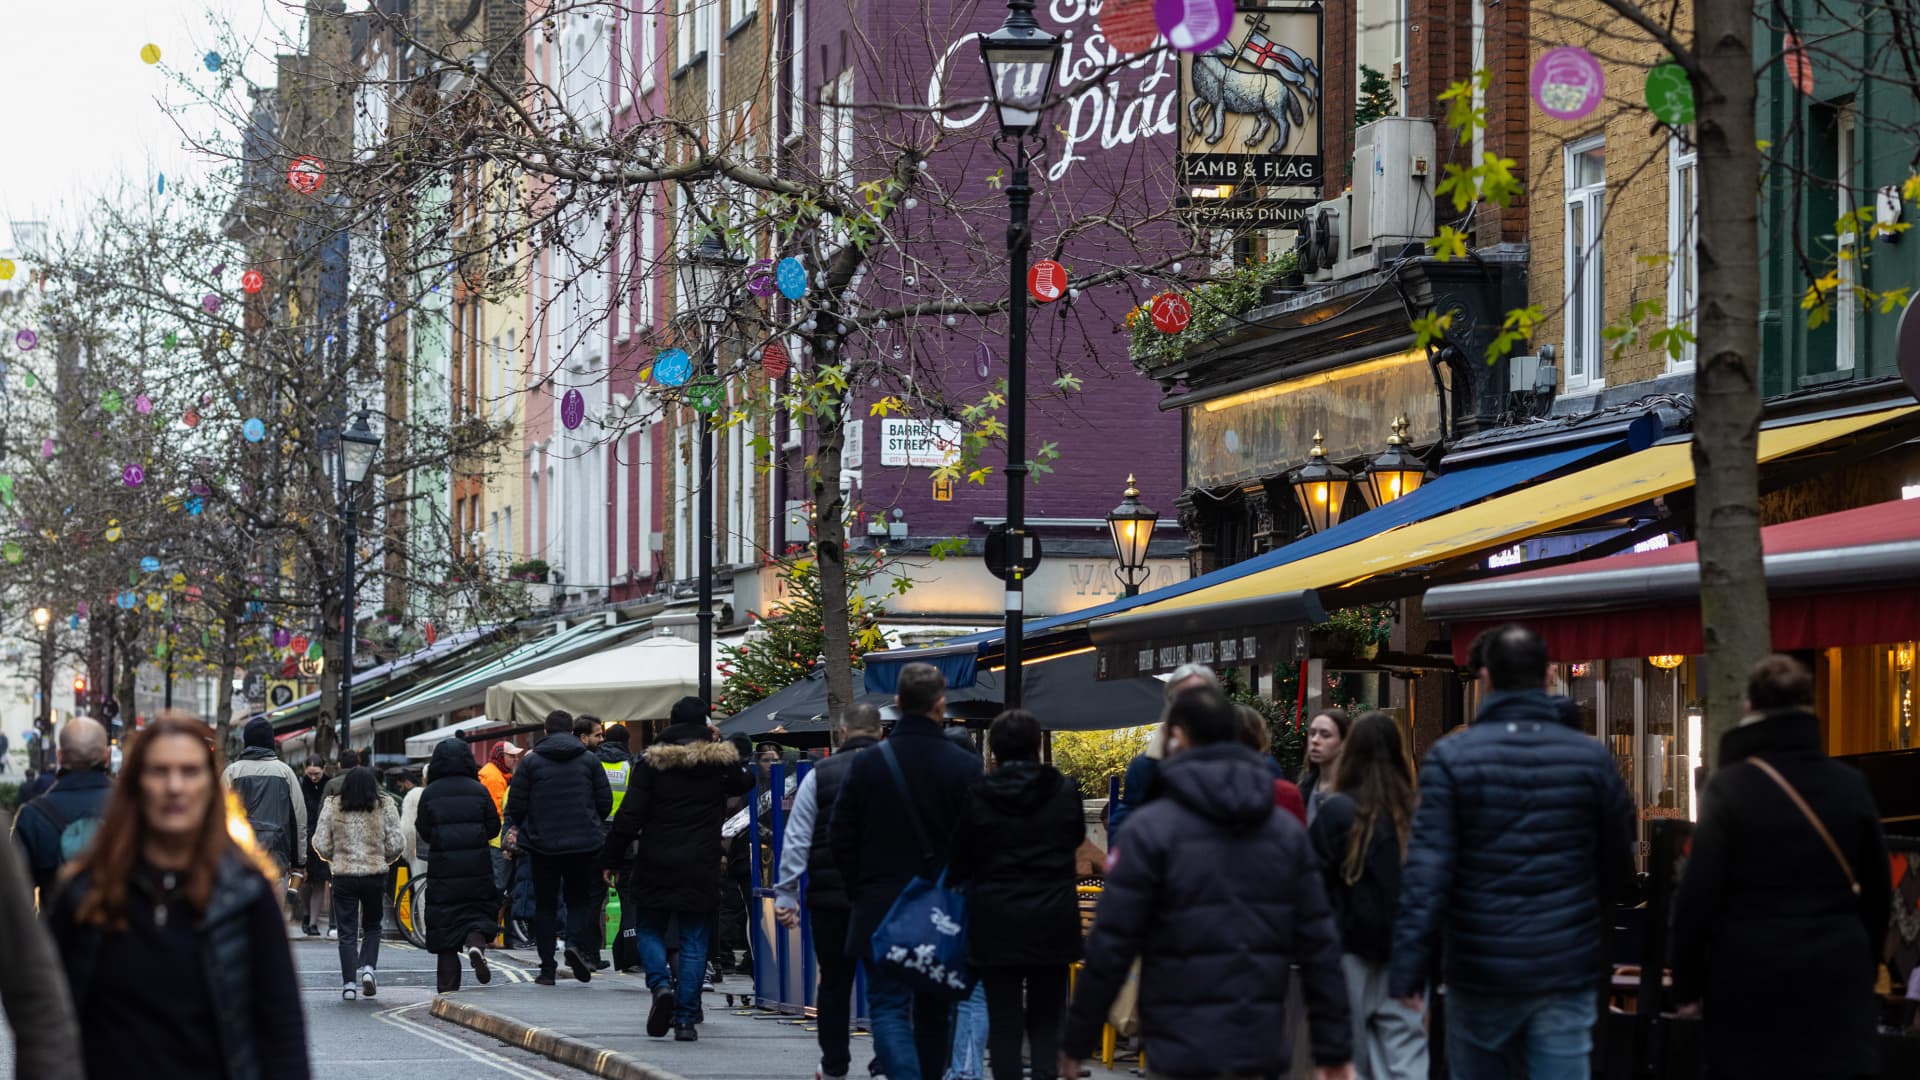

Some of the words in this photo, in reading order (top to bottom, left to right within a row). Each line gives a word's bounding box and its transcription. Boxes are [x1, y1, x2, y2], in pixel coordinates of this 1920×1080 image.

[1184, 161, 1237, 176] LAMB
[1243, 162, 1257, 176] &
[1264, 162, 1313, 178] FLAG
[1258, 208, 1305, 220] DiNIN
[889, 424, 941, 437] BARRETT
[889, 438, 930, 450] STREET
